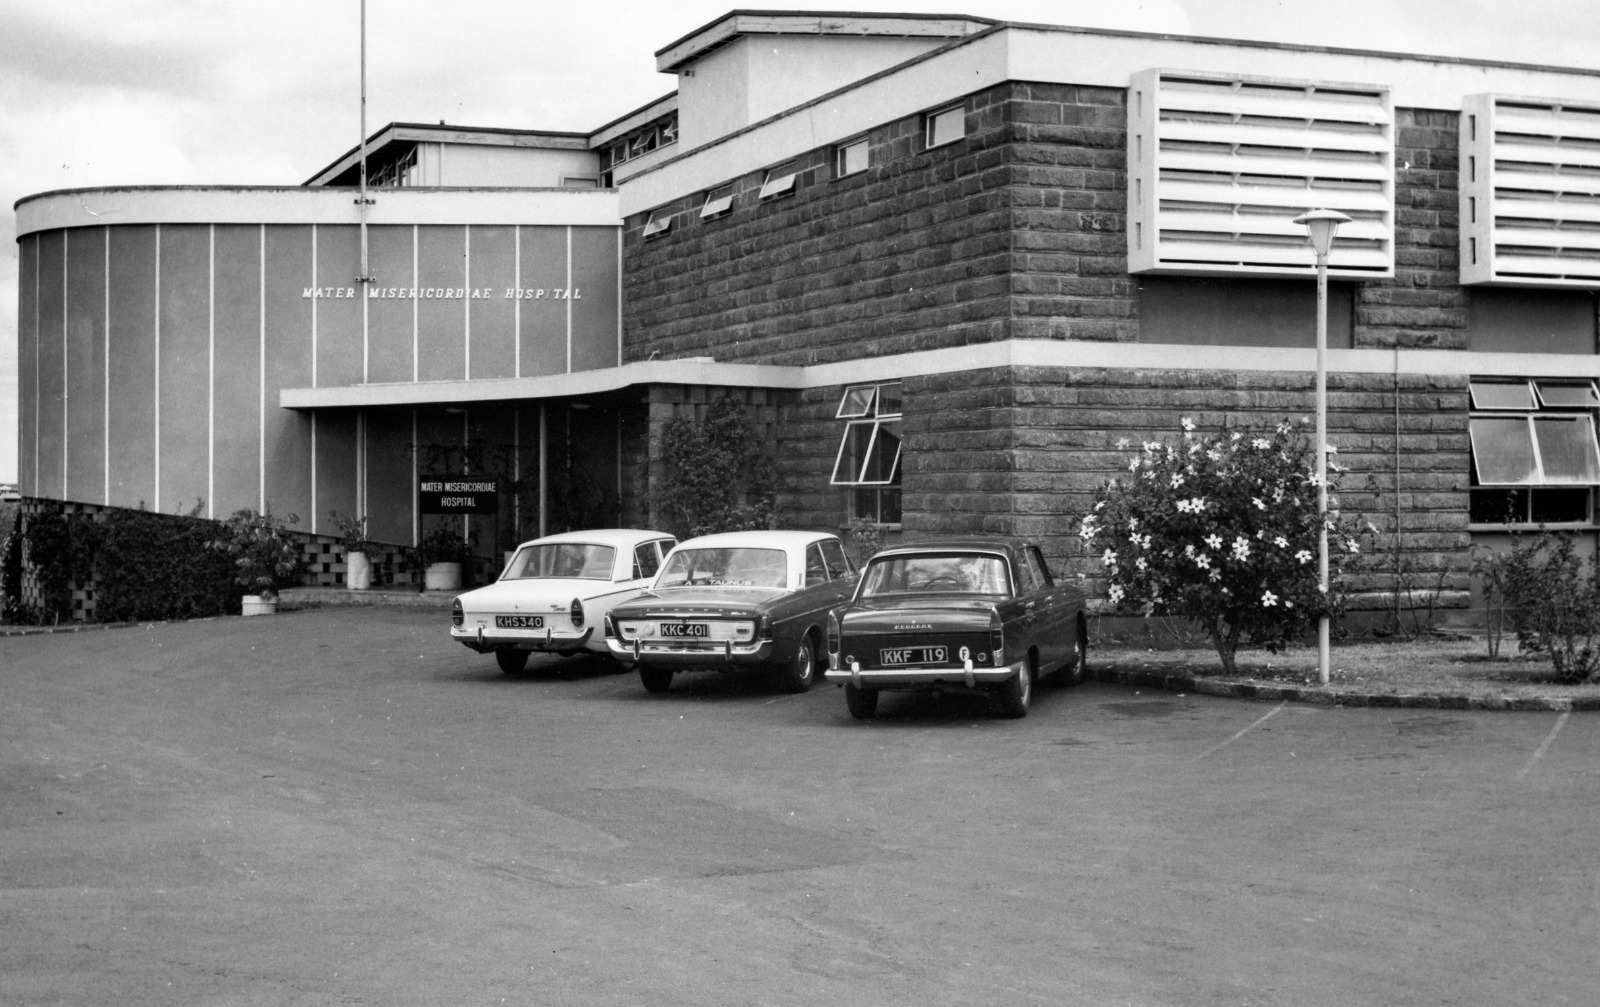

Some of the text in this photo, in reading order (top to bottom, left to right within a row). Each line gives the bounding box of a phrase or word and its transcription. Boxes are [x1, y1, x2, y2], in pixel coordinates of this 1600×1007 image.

[302, 287, 355, 298] MATER
[368, 288, 492, 299] MISERICORDIAE
[421, 482, 496, 492] MATER MISERICORDIAE
[441, 497, 476, 507] HOSPITAL
[661, 625, 706, 636] KKC 401
[883, 648, 945, 664] KKF 119
